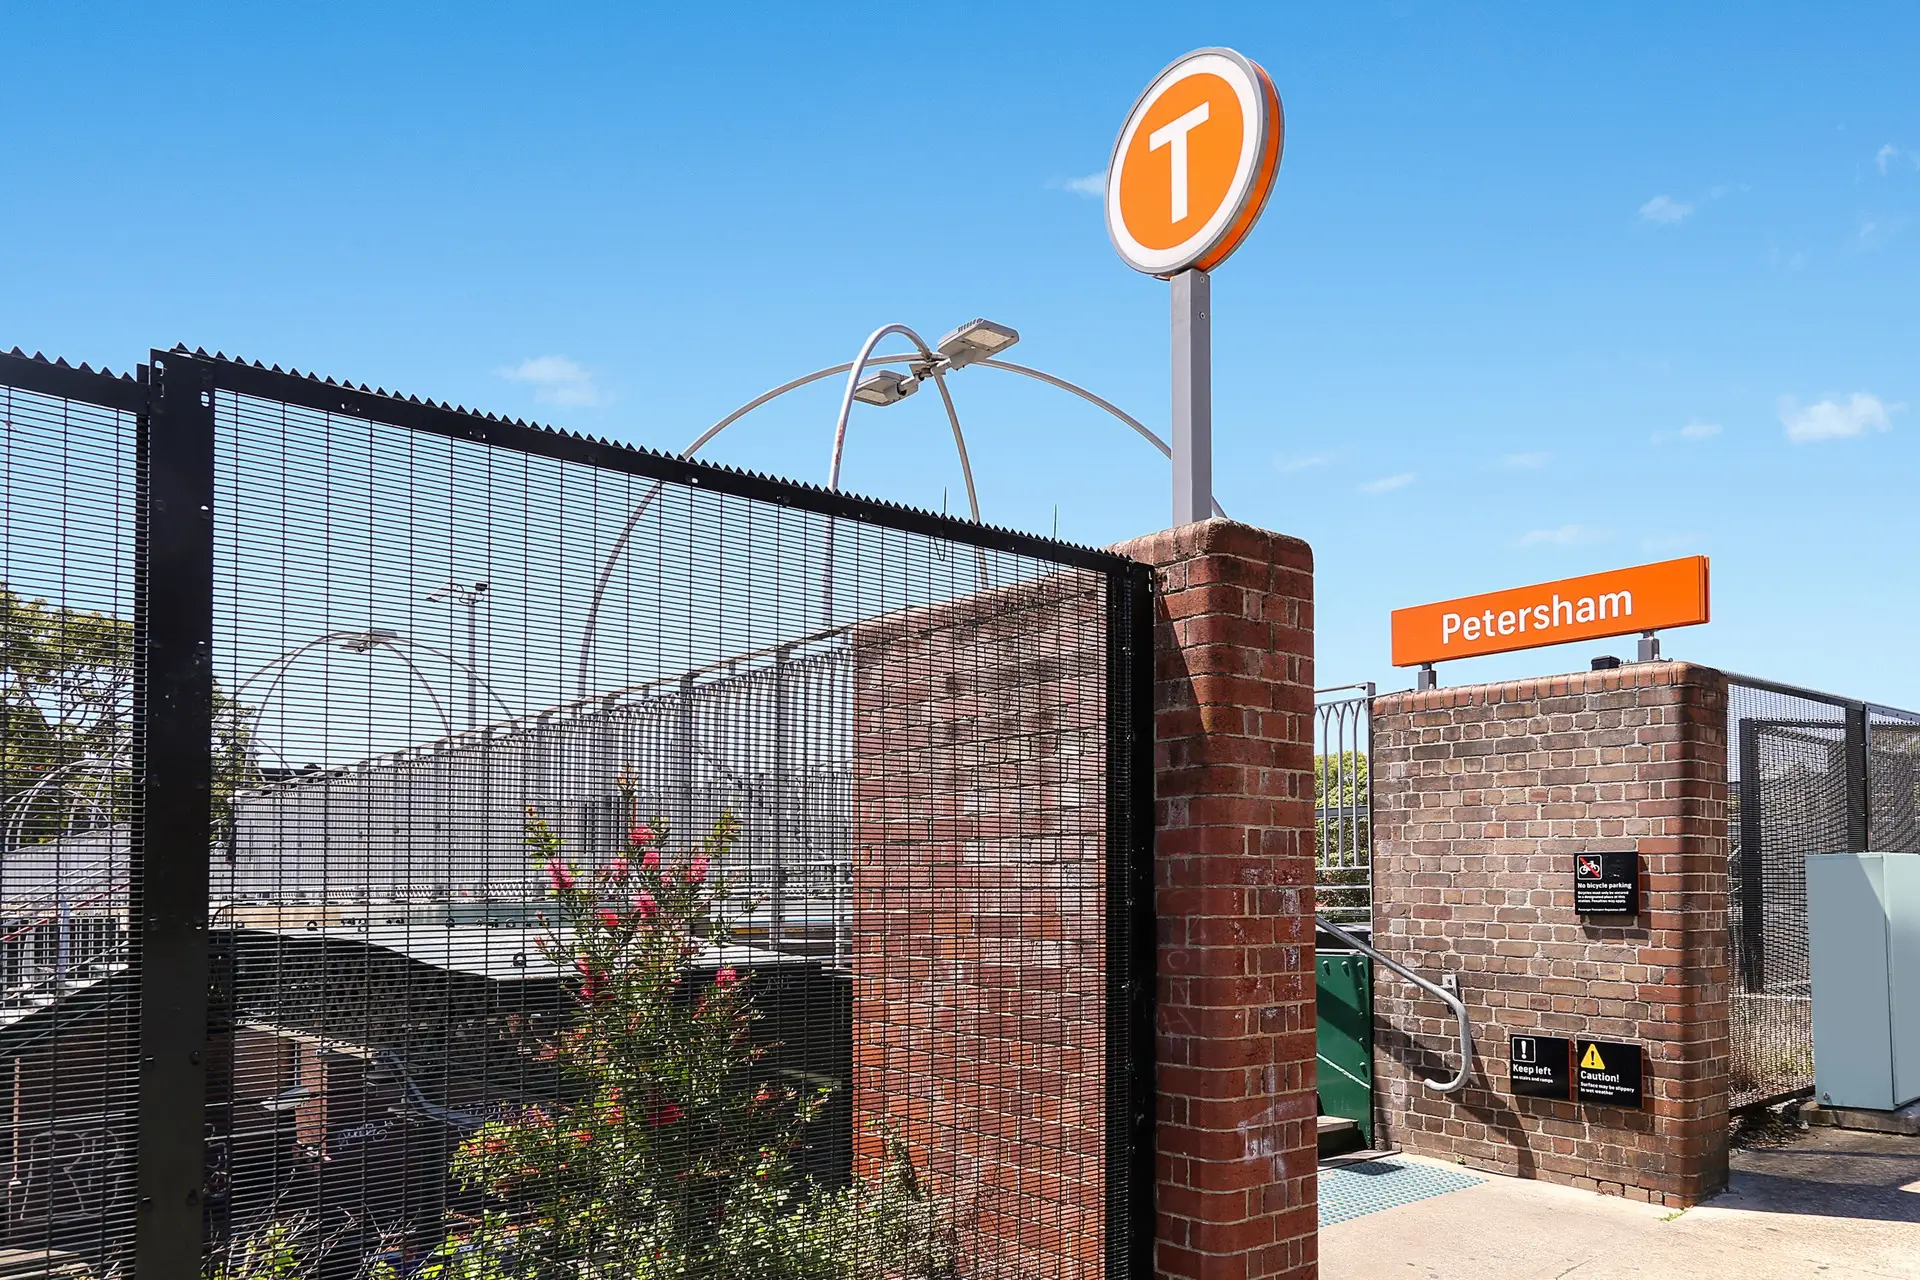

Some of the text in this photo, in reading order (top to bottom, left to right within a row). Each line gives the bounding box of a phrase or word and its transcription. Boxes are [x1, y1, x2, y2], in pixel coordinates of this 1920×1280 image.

[1150, 101, 1209, 224] T
[1442, 590, 1632, 644] Petersham
[1512, 1064, 1552, 1076] Keep left
[1580, 1070, 1620, 1082] Caution!
